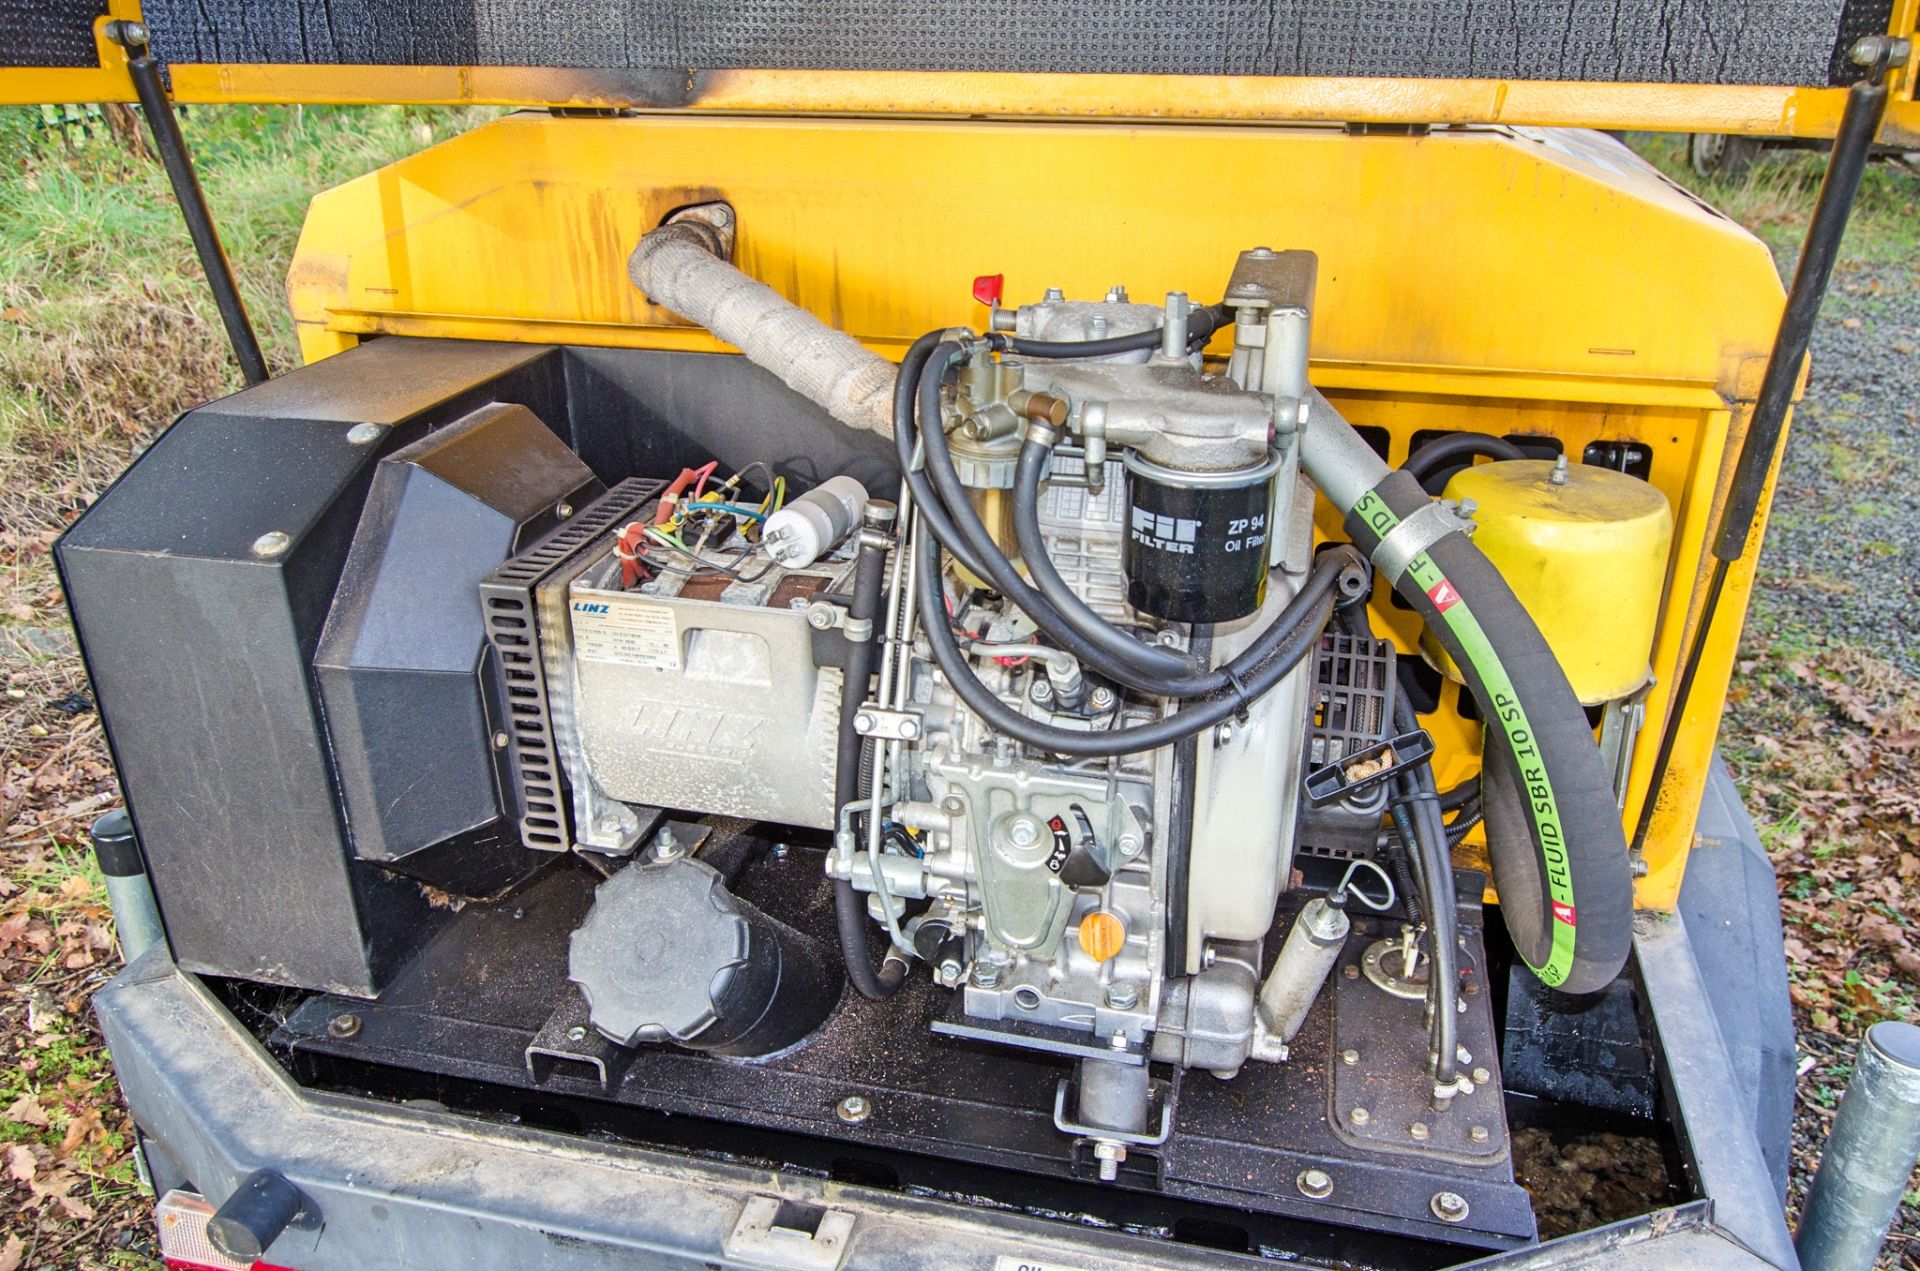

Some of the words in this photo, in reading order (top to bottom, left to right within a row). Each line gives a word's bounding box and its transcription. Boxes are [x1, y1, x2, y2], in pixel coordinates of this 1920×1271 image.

[1227, 519, 1248, 535] ZP
[1250, 513, 1265, 531] 94
[1131, 530, 1195, 554] FILTER
[1224, 540, 1241, 553] Oil
[1245, 533, 1267, 549] Filter
[573, 602, 610, 614] LINZ
[1495, 692, 1521, 721] SP
[1511, 728, 1536, 759] 10
[1525, 765, 1554, 814] SBR
[1541, 827, 1567, 888] FLUID
